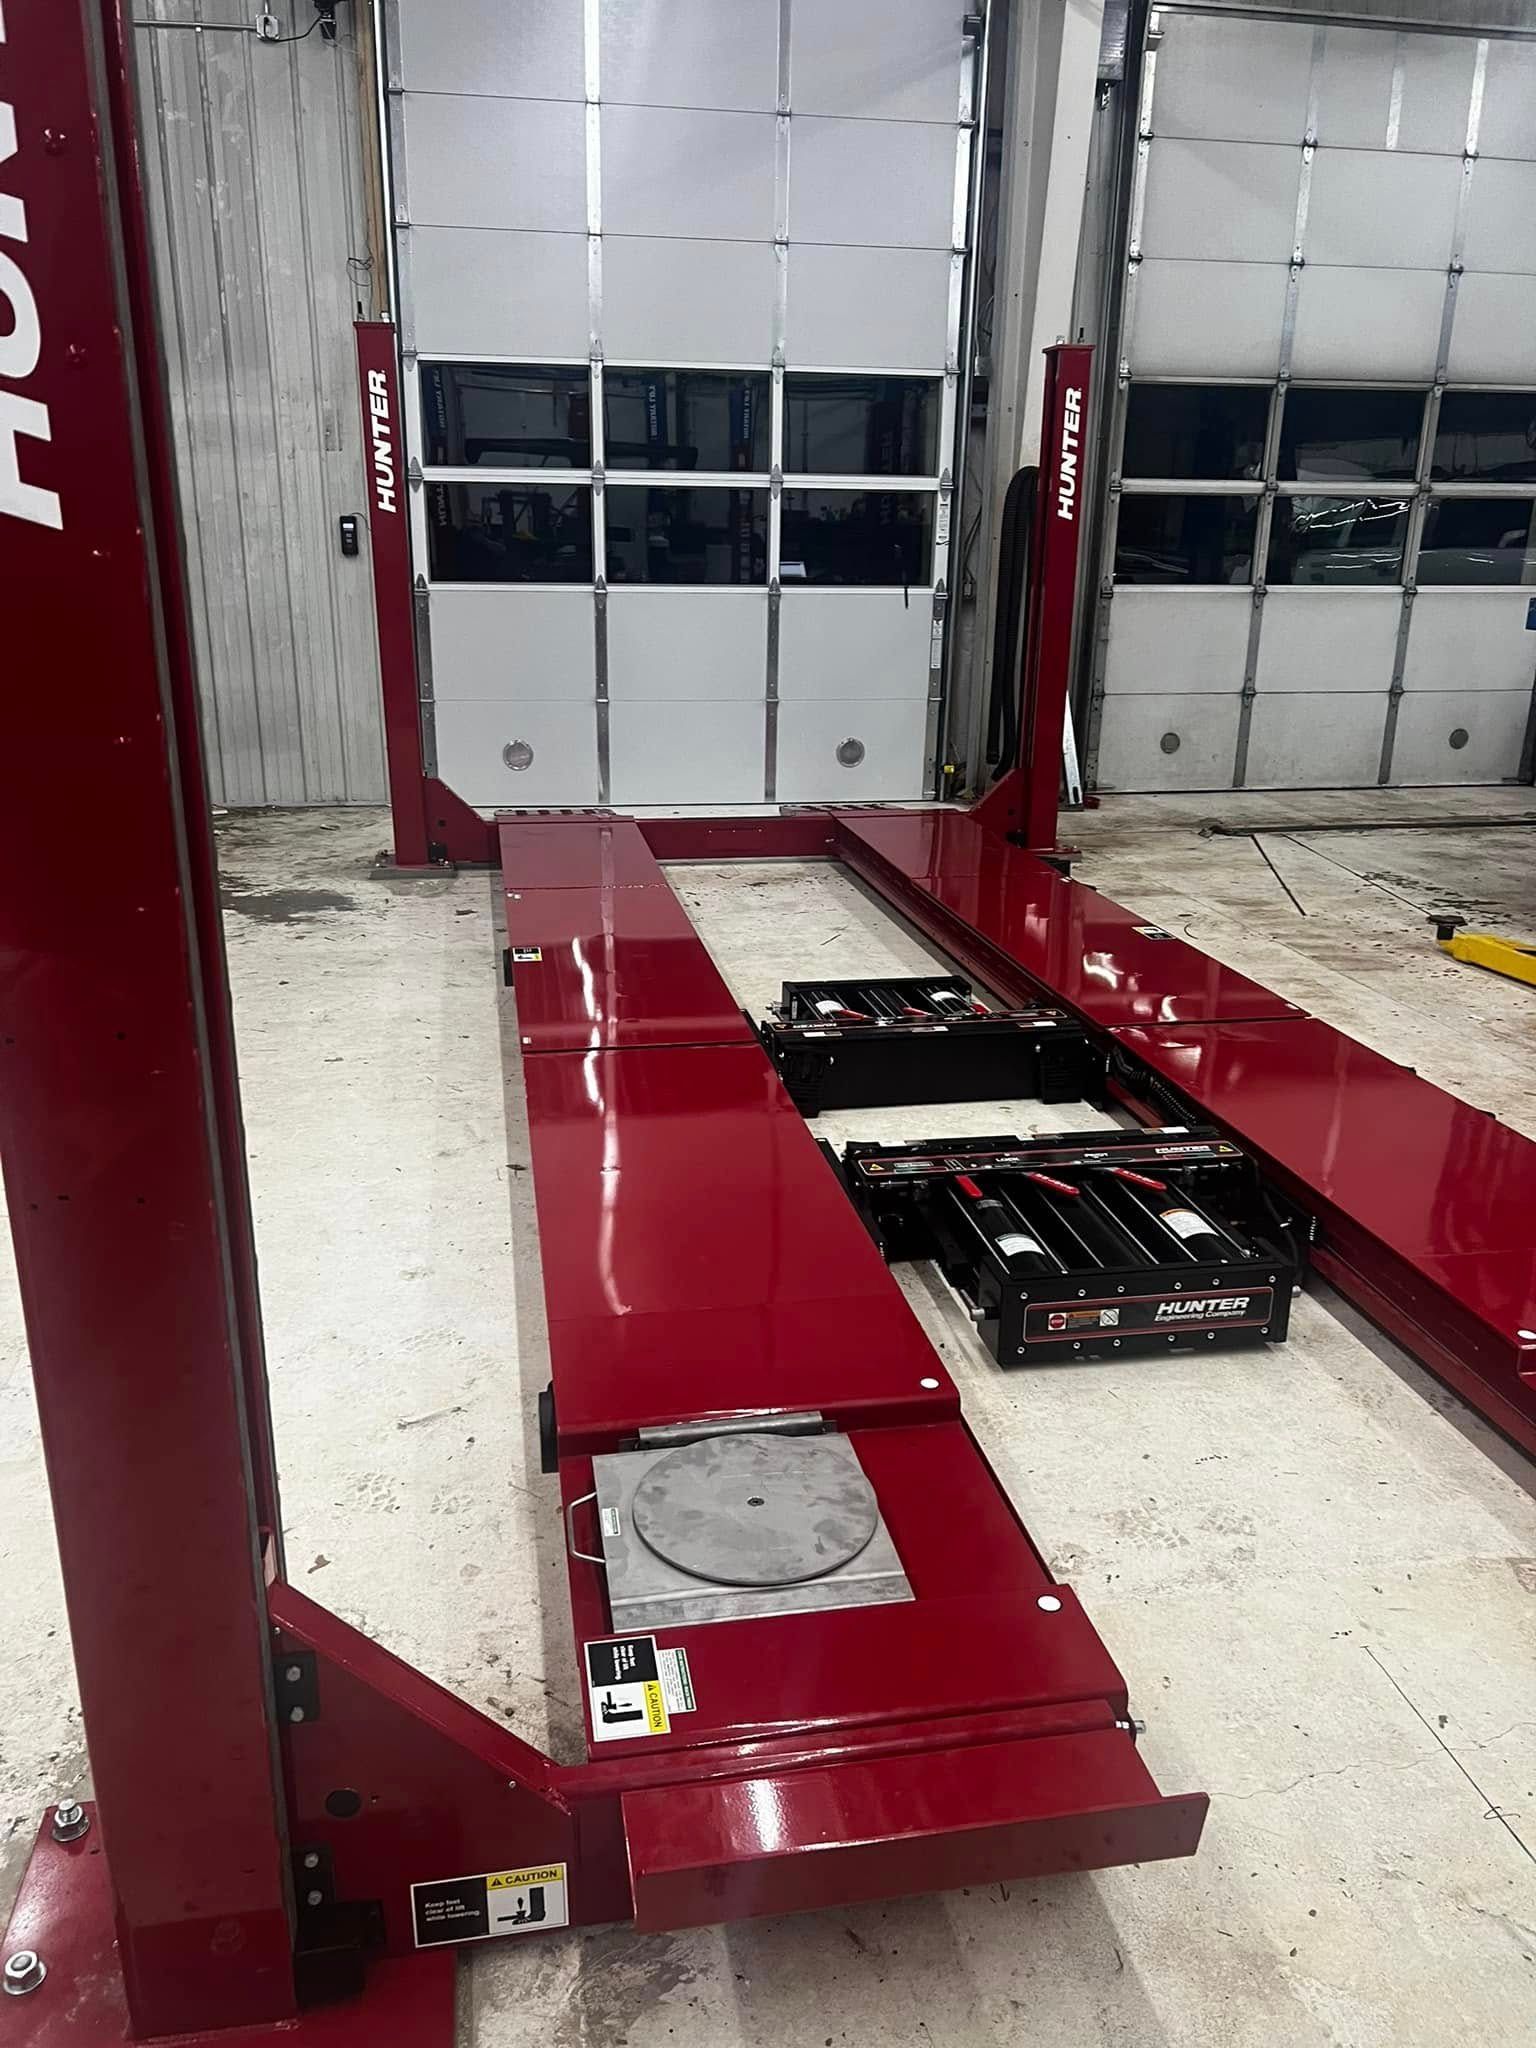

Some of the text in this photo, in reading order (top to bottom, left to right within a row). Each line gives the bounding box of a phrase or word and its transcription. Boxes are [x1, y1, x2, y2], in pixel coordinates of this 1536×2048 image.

[368, 370, 397, 513] HUNTER
[1057, 387, 1082, 521] HUNTER
[1157, 1297, 1250, 1314] HUNTER
[1154, 1310, 1246, 1322] Engineering Company
[650, 1692, 663, 1728] CAUTION
[505, 1869, 558, 1884] CAUTION
[447, 1909, 480, 1919] lowering
